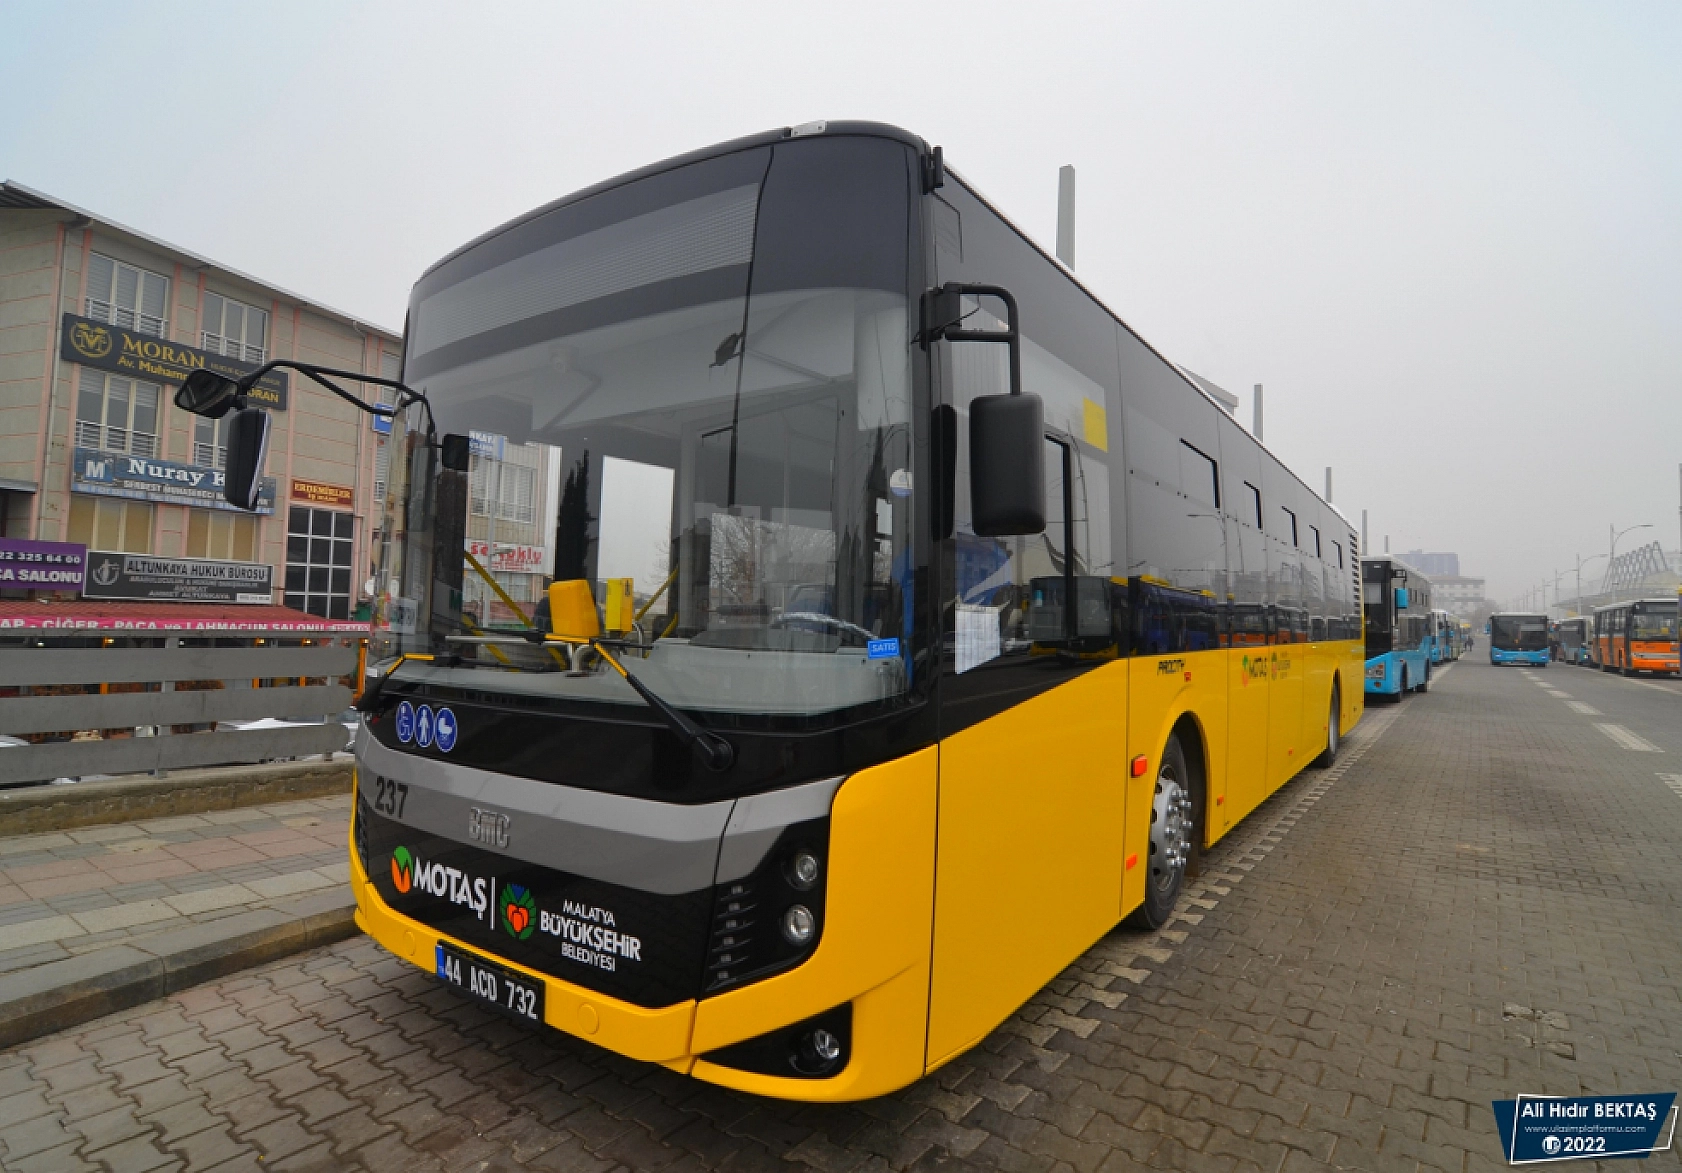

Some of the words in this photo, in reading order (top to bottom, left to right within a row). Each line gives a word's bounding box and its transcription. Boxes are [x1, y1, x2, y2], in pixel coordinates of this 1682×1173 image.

[122, 333, 205, 368] MORAN
[127, 458, 205, 487] Nuray
[17, 569, 83, 584] SALONU
[126, 560, 188, 576] ALTUNKAYA
[190, 563, 226, 579] HUKUK
[374, 775, 409, 820] 237
[468, 806, 511, 849] BMC
[413, 856, 488, 921] MOTAŞ
[563, 898, 616, 928] MALATYA
[445, 955, 462, 986] 44
[470, 965, 498, 1003] ACD
[505, 979, 539, 1020] 732
